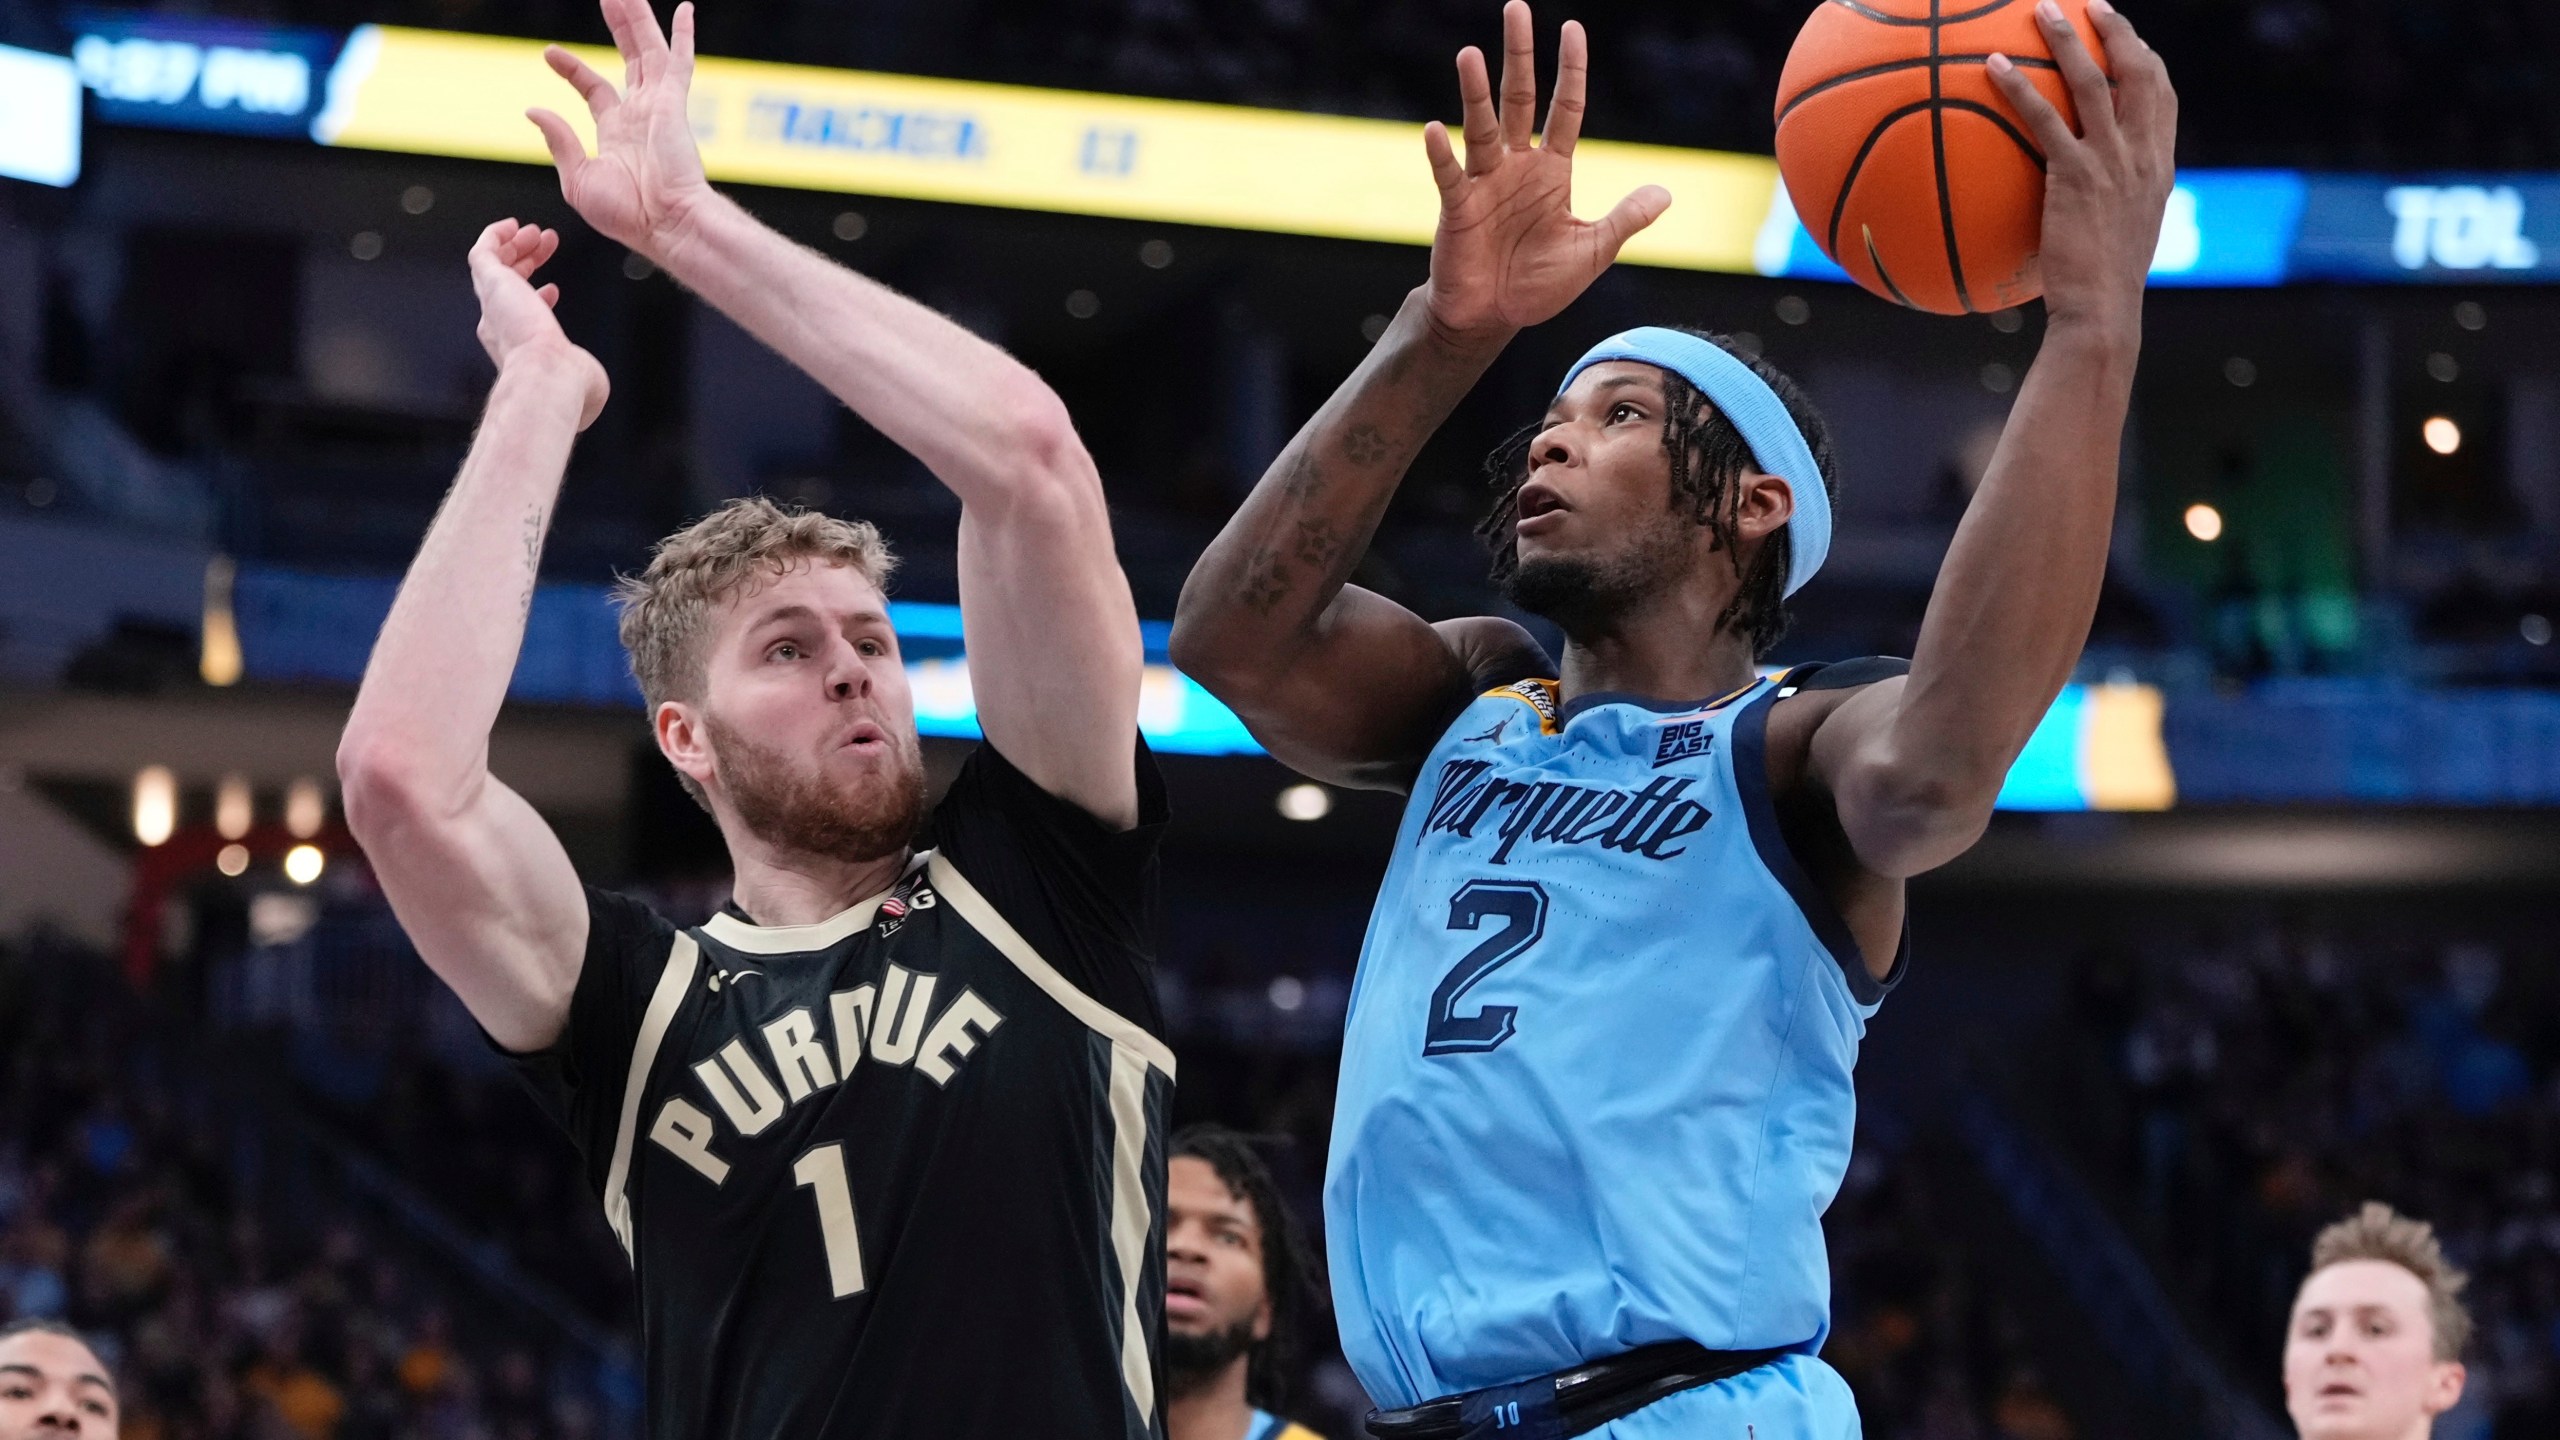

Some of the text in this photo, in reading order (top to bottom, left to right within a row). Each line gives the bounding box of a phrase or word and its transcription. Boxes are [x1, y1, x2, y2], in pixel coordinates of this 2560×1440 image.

[2386, 185, 2538, 270] TOL
[1655, 734, 1714, 760] EAST
[1660, 720, 1704, 743] BIG
[1416, 759, 1713, 865] Marquette
[1422, 879, 1549, 1057] 2
[647, 959, 1007, 1190] PURDUE
[790, 1139, 869, 1301] 1
